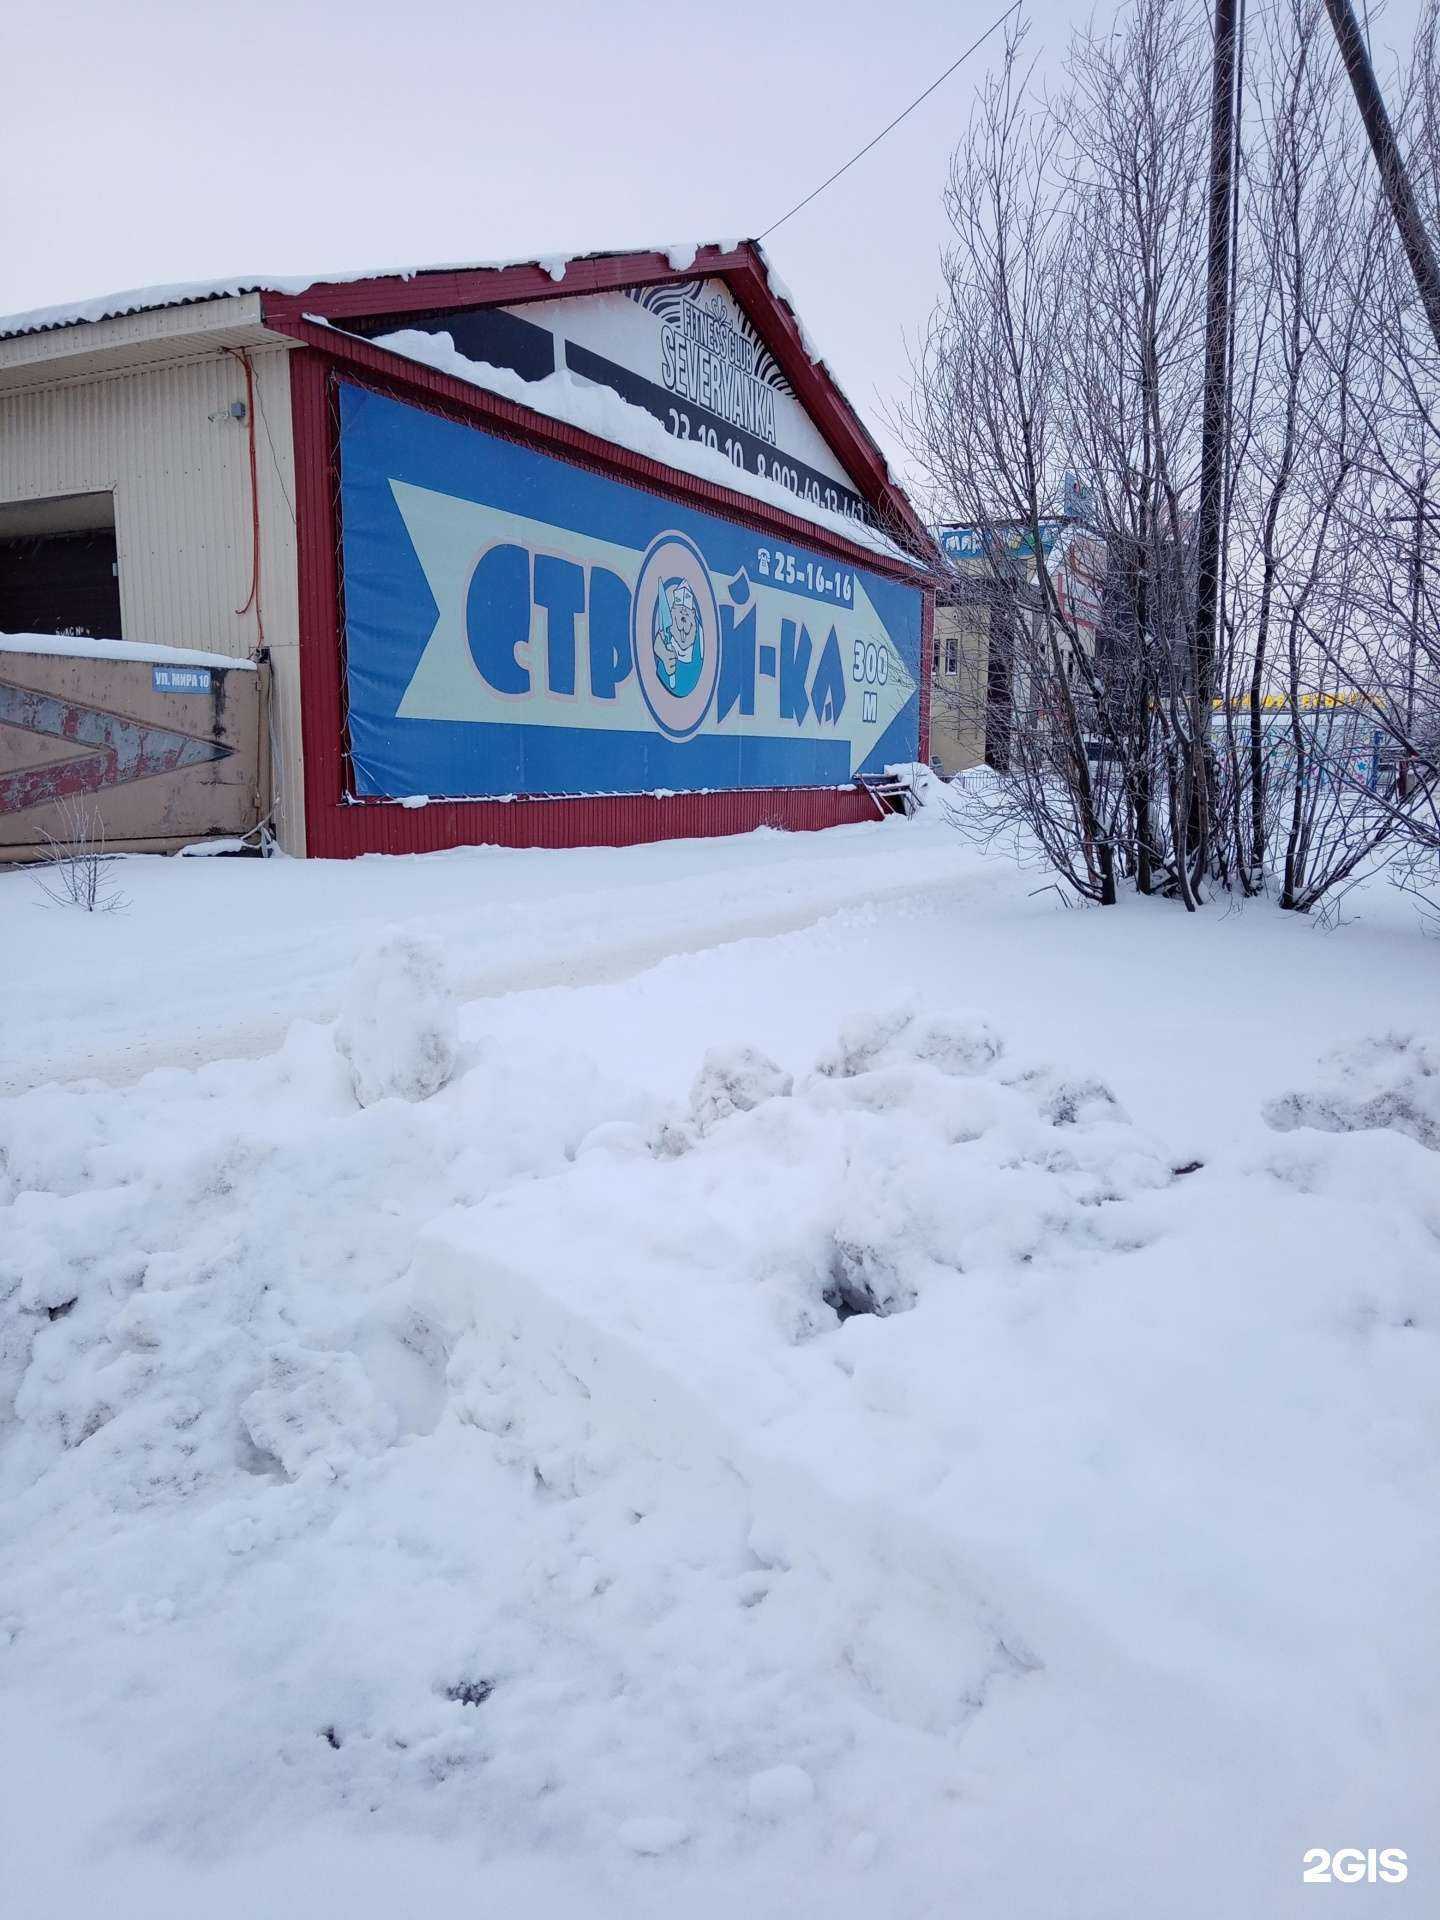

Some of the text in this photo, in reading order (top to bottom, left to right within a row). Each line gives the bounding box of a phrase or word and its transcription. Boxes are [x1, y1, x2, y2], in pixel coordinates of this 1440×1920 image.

[682, 299, 754, 375] FITNESS CLUB
[660, 324, 777, 447] SEVERYANKA
[774, 551, 852, 601] 25-16-16
[199, 674, 210, 688] 10
[853, 639, 888, 686] 300
[862, 690, 878, 723] М
